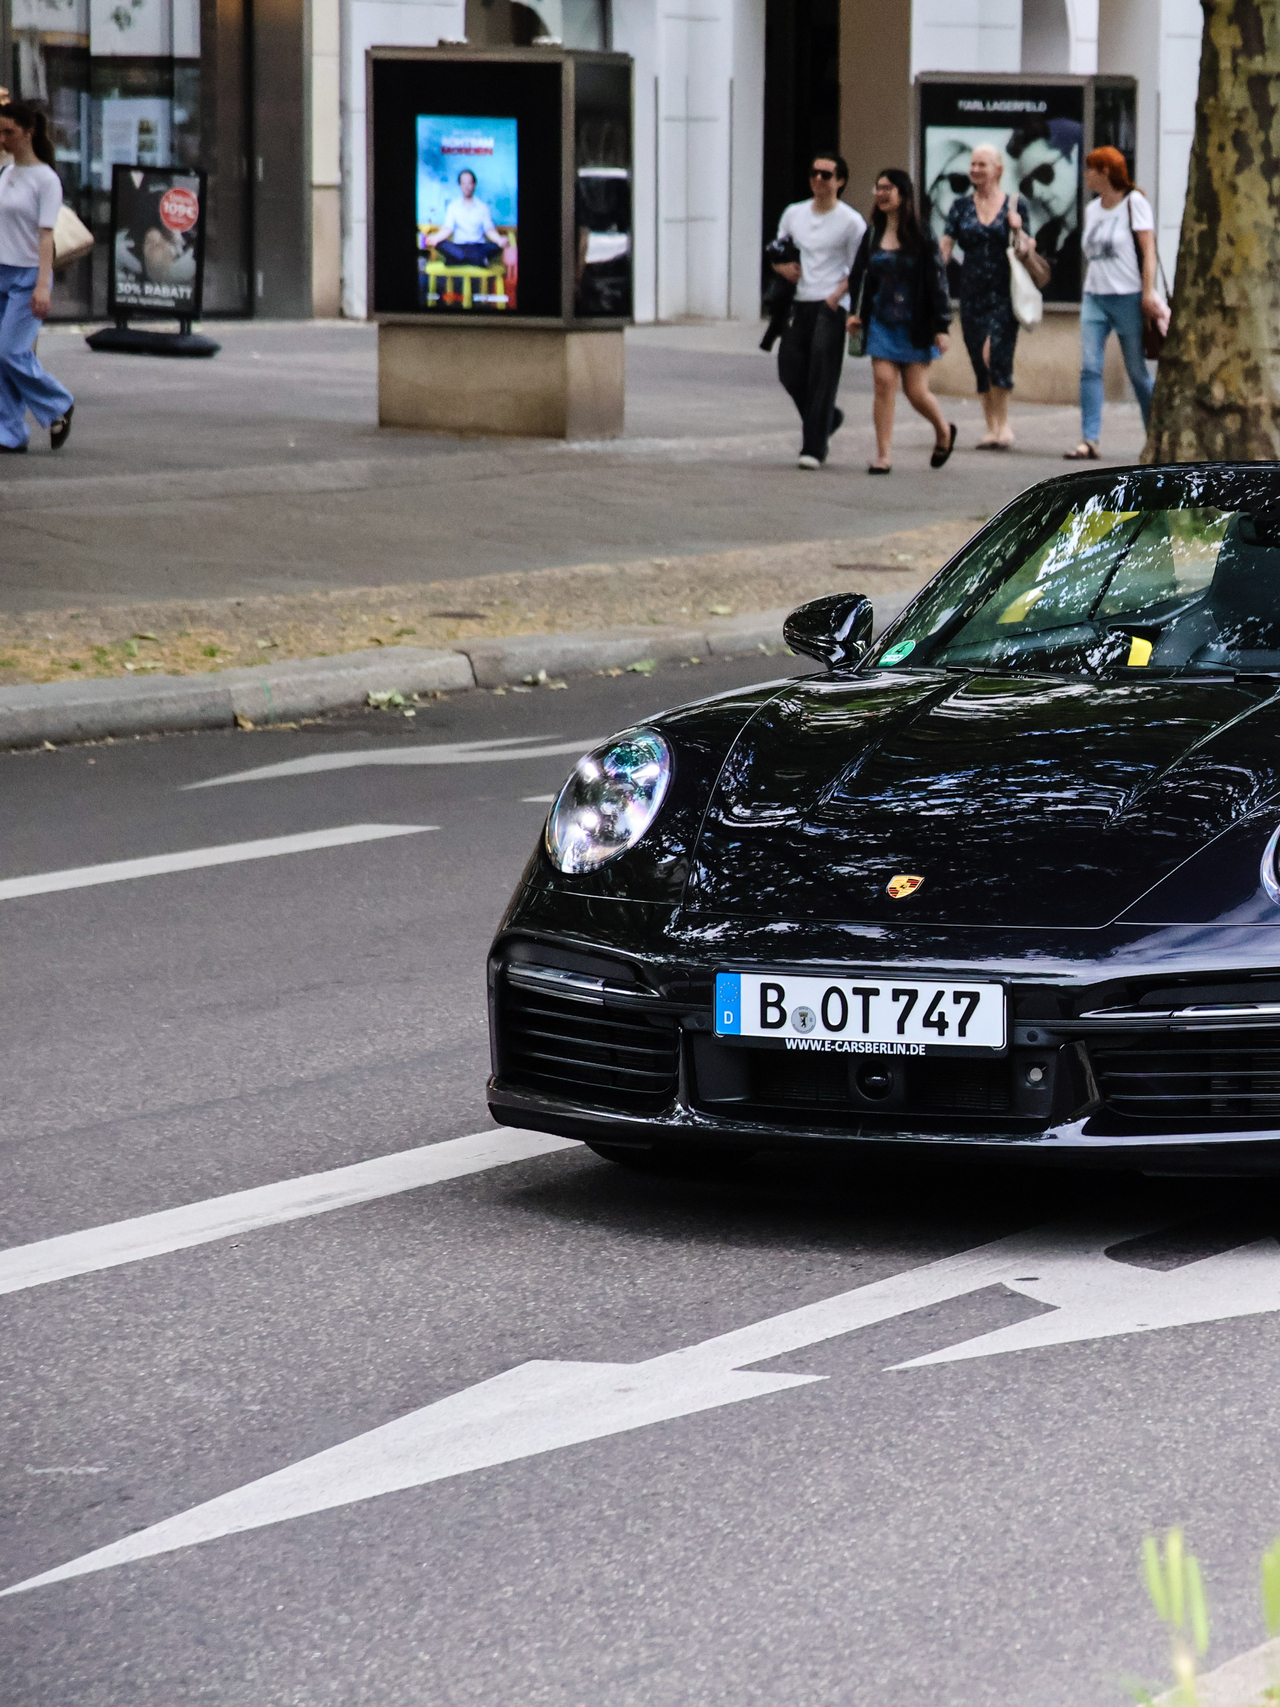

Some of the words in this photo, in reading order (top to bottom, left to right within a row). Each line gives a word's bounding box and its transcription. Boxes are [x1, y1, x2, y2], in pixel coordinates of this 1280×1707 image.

[986, 100, 1048, 112] LAGERFELD
[144, 283, 193, 299] RABATT
[724, 1010, 734, 1025] D
[760, 982, 787, 1030] B
[821, 985, 880, 1034] OT
[891, 987, 981, 1038] 747
[785, 1037, 927, 1056] WWW.E-CARSBERLIN.DE
